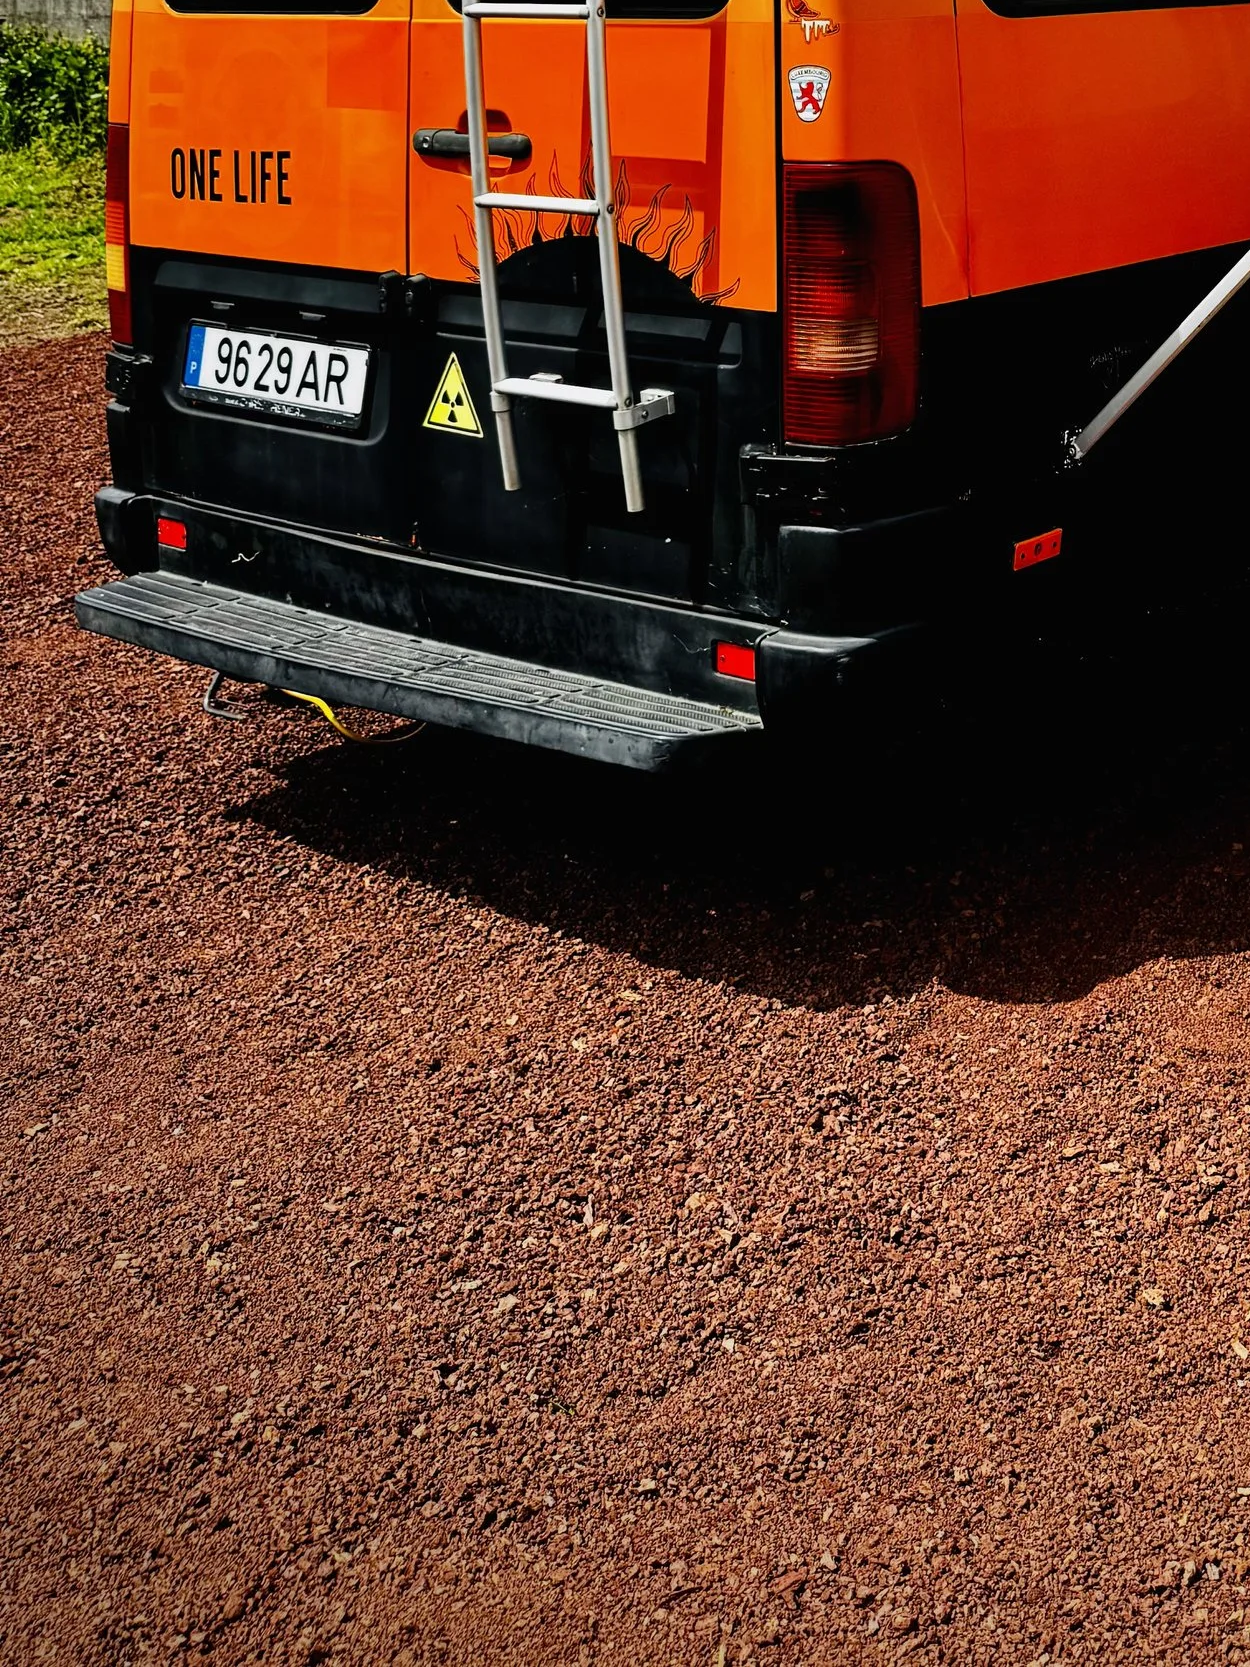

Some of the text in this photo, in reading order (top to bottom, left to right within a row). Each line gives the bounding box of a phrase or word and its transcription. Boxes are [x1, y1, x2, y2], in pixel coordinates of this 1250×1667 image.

[171, 147, 292, 205] ONE LIFE
[189, 361, 198, 374] P
